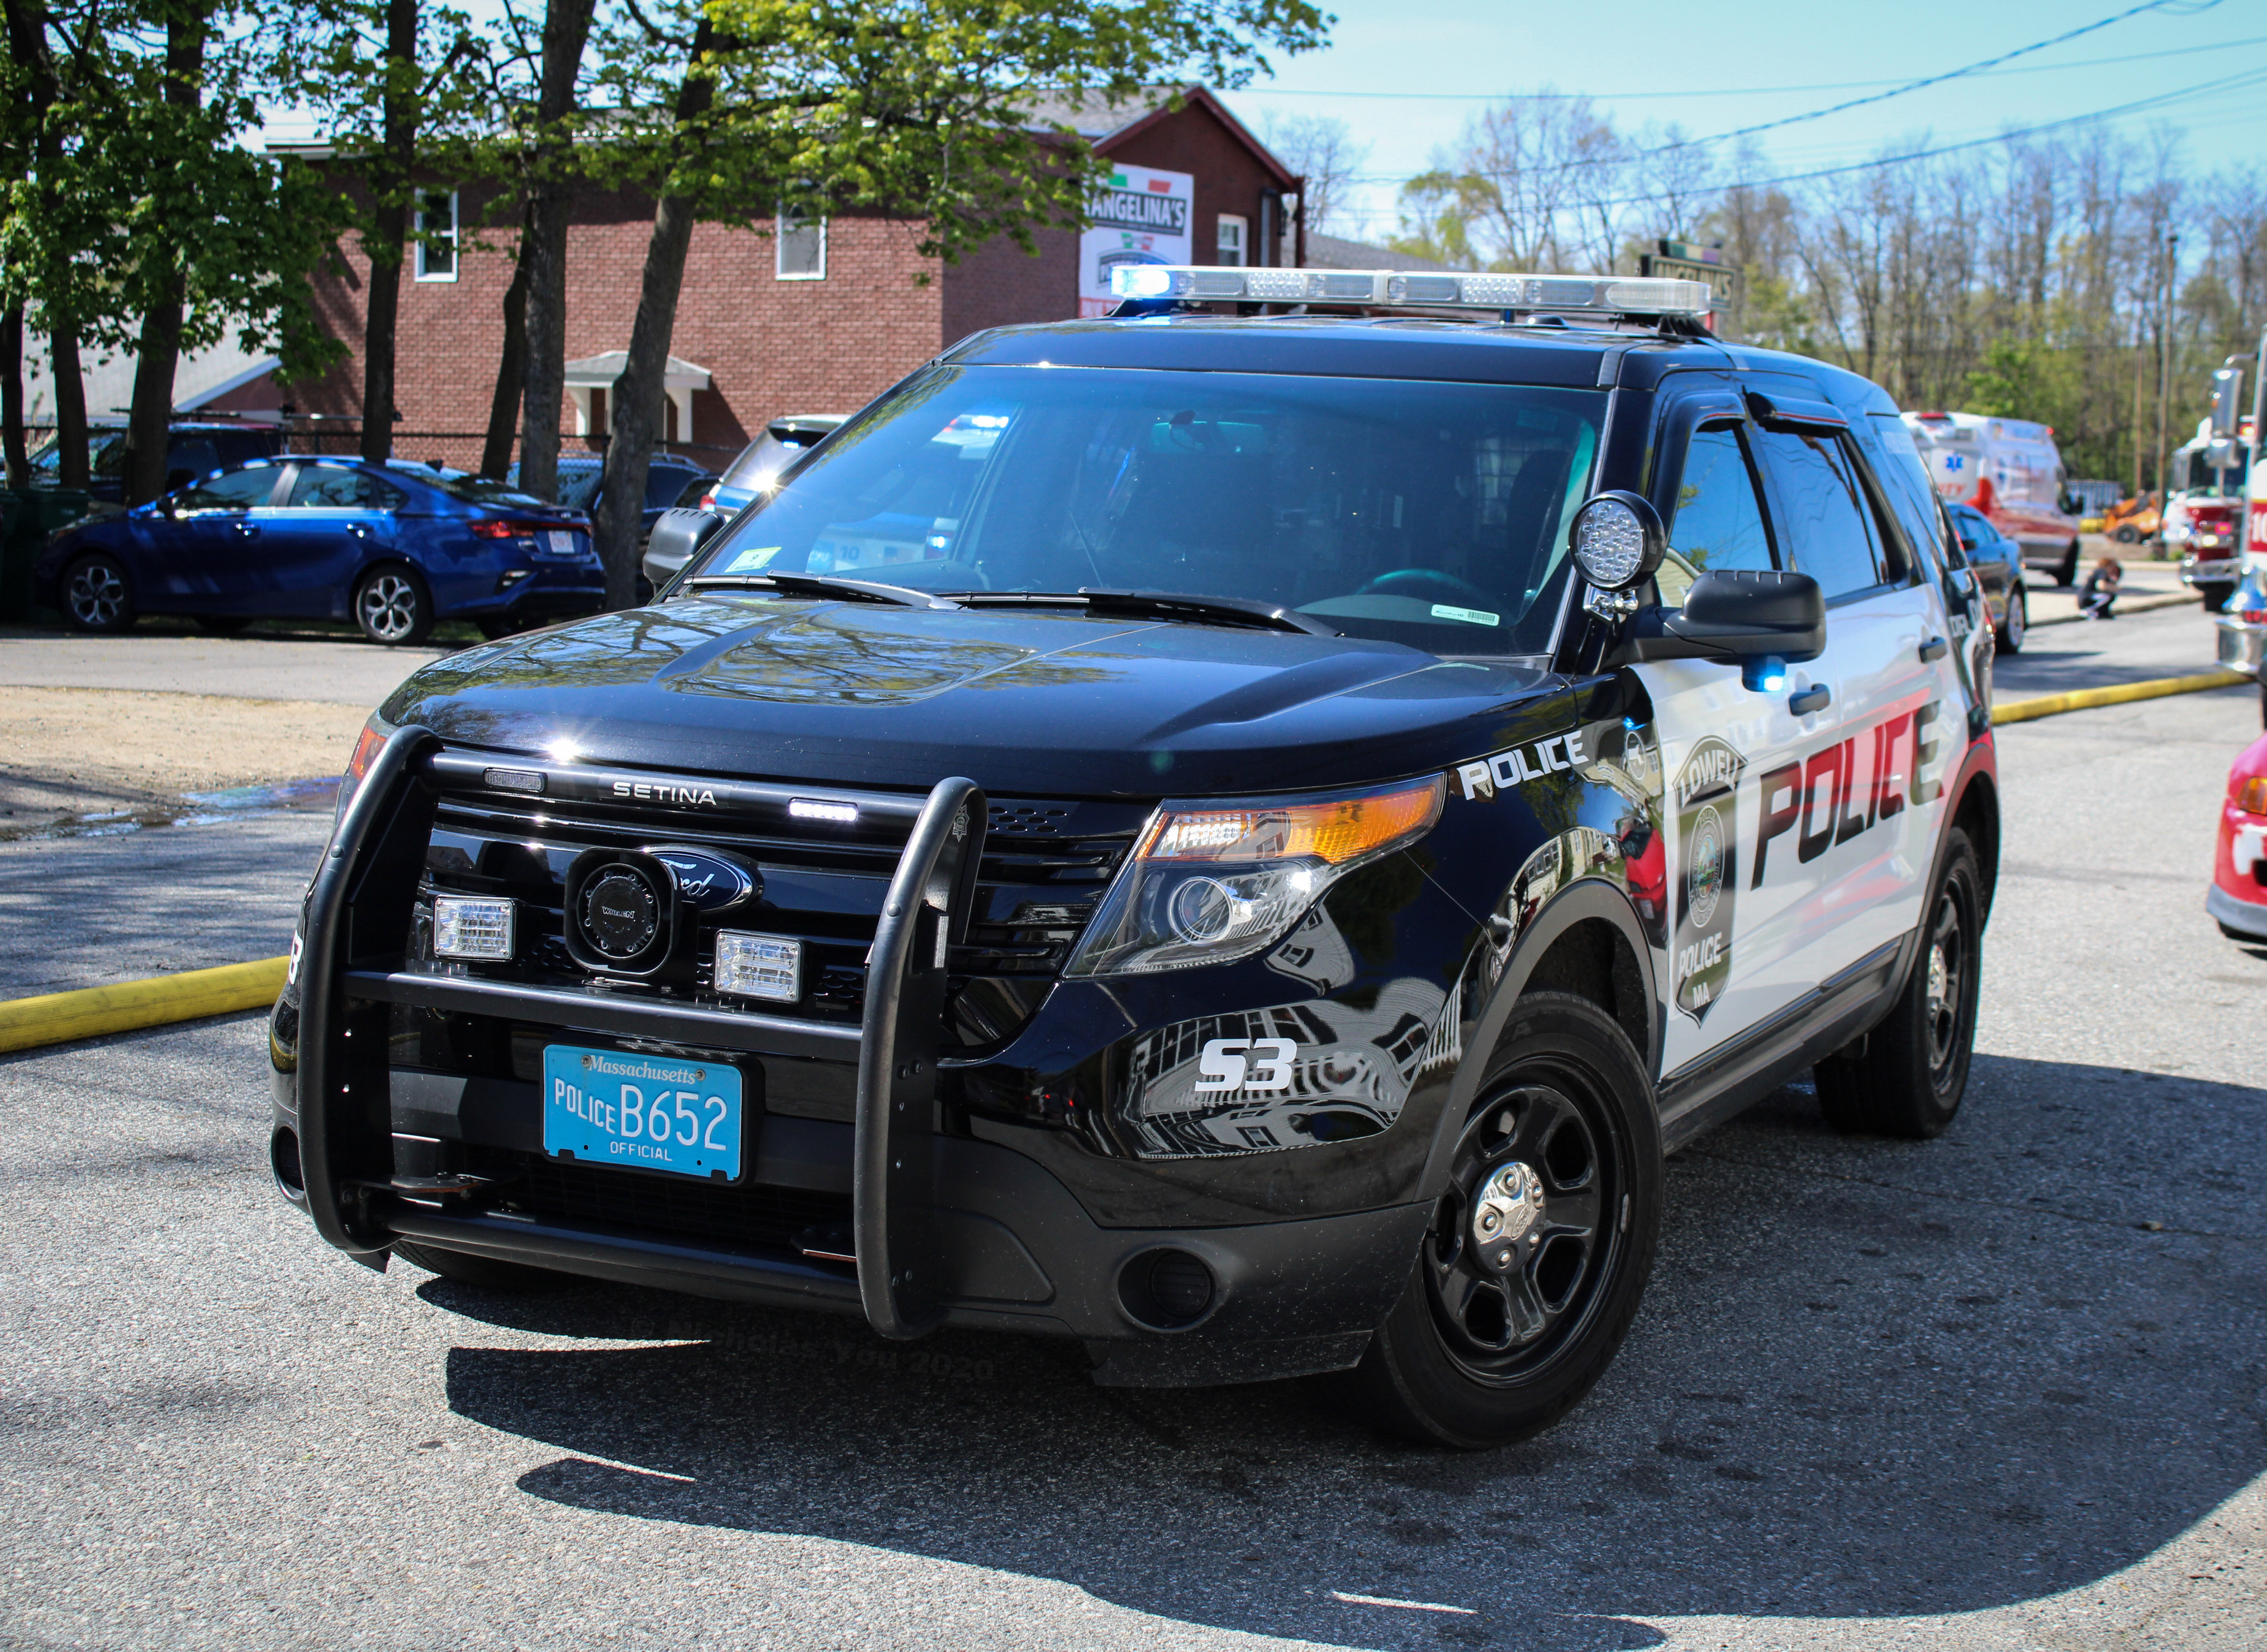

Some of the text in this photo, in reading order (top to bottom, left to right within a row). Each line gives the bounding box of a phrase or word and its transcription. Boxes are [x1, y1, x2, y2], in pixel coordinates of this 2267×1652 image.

[1456, 730, 1589, 801] POLICE
[1680, 749, 1740, 808] LOWELL
[613, 782, 717, 806] SETINA
[1750, 699, 1945, 892] POLICE
[602, 906, 635, 919] WHELEN
[1677, 932, 1723, 983] POLICE
[1693, 982, 1710, 1009] MA
[589, 1054, 696, 1085] Massachusetts
[1195, 1037, 1298, 1092] S3
[554, 1077, 727, 1151] POLICE B652
[609, 1141, 673, 1161] OFFICIAL
